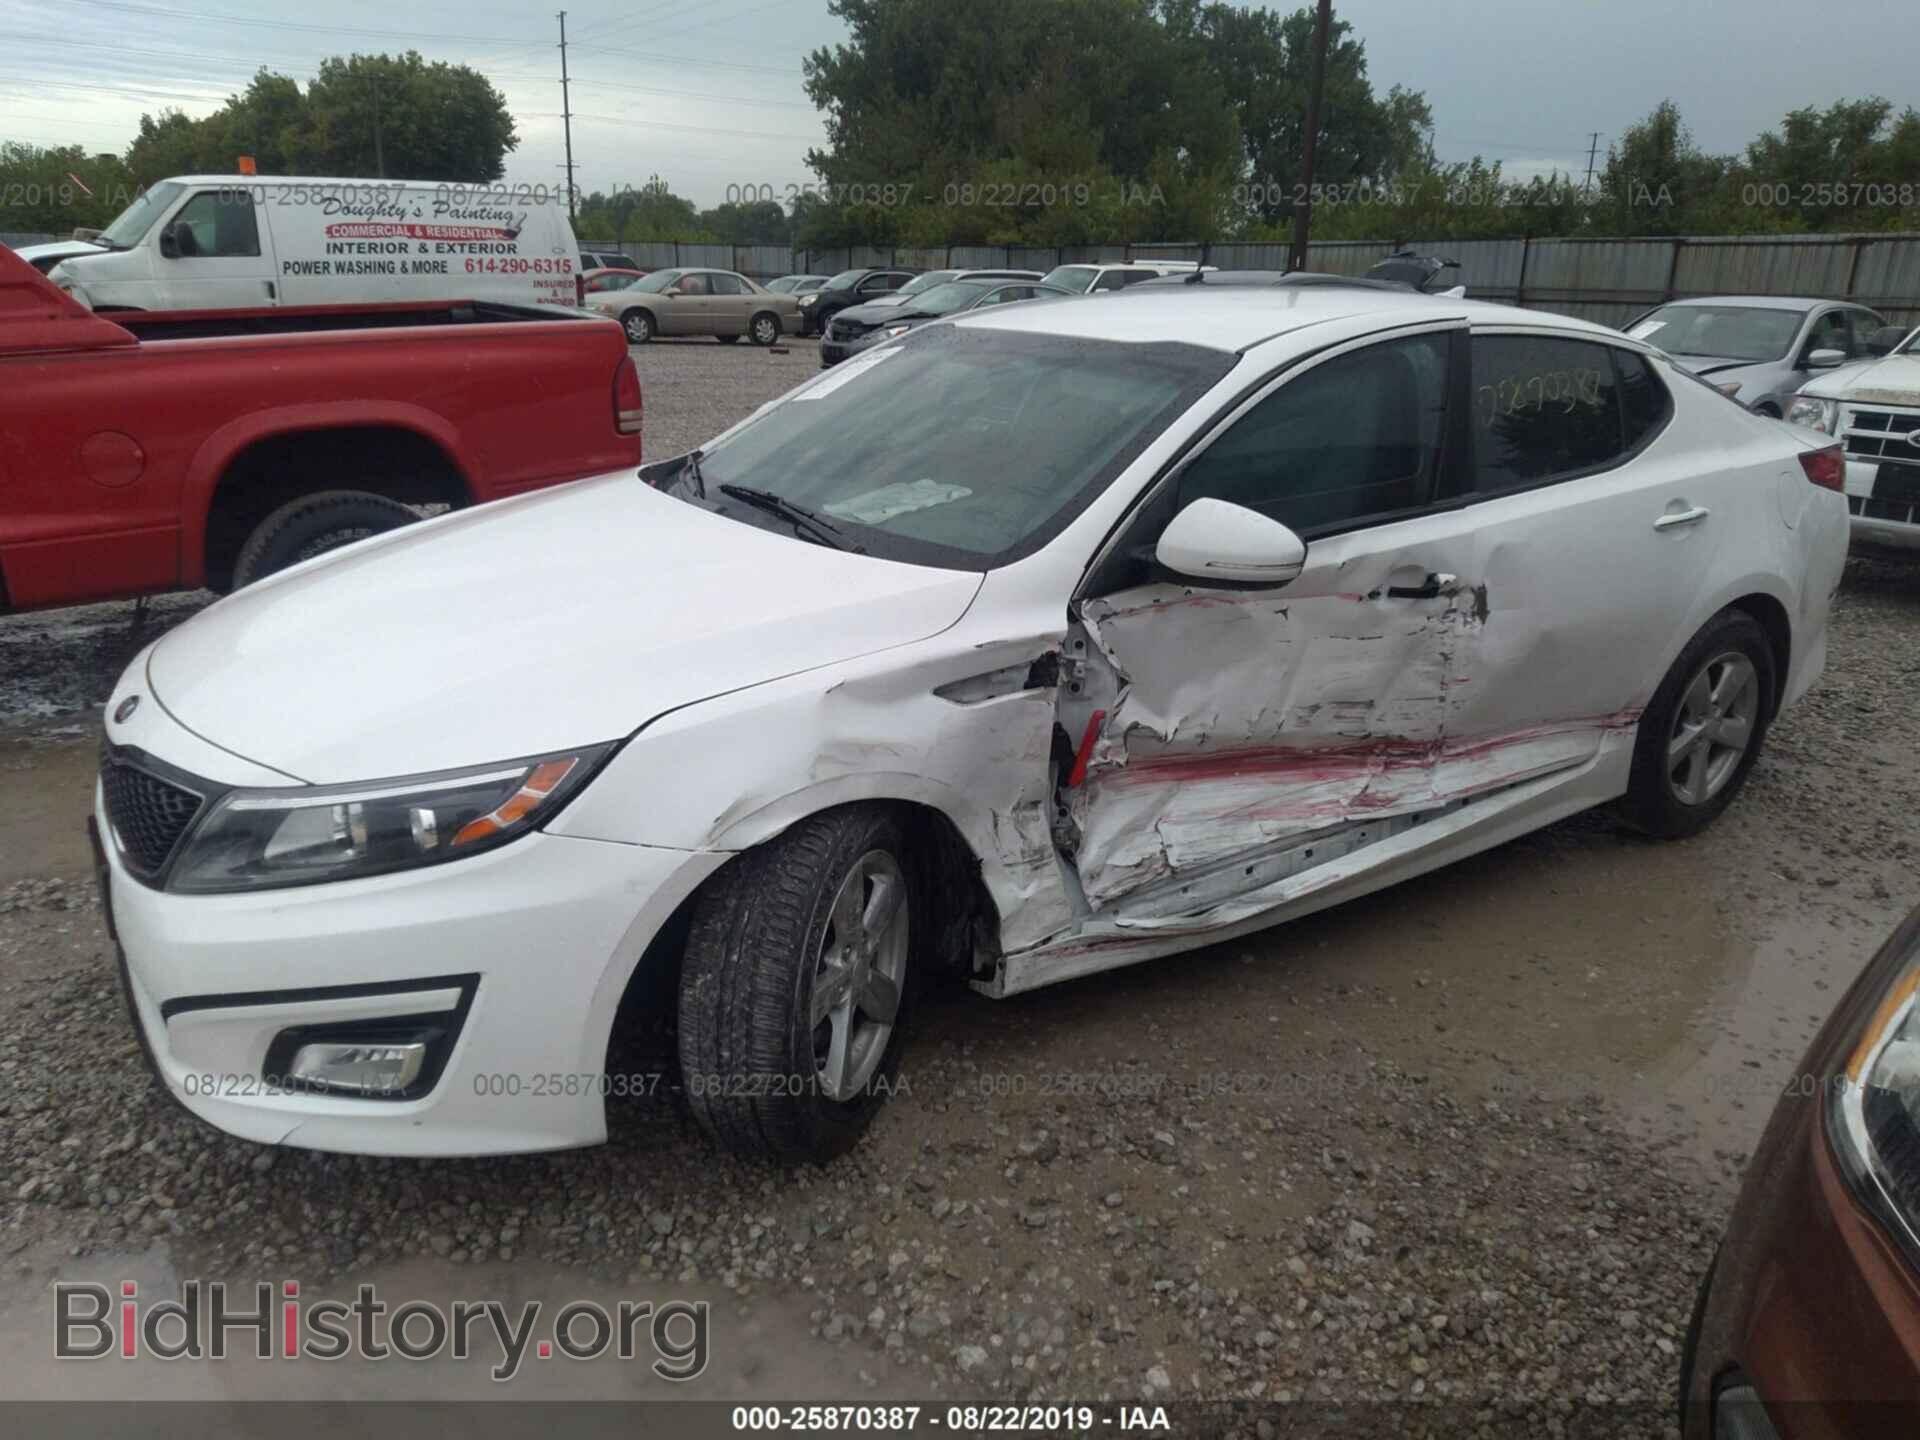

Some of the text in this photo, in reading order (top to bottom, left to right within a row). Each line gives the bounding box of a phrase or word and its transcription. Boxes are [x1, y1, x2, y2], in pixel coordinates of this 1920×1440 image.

[320, 197, 513, 226] Doughty's Painting
[332, 225, 497, 239] COMMERCIAL & RESIDENTIAL
[326, 242, 517, 254] INTERIOR & EXTERIOR
[283, 261, 448, 275] POWER WASHING & MORE
[464, 257, 572, 274] 614-290-6315
[533, 279, 575, 288] INSURED
